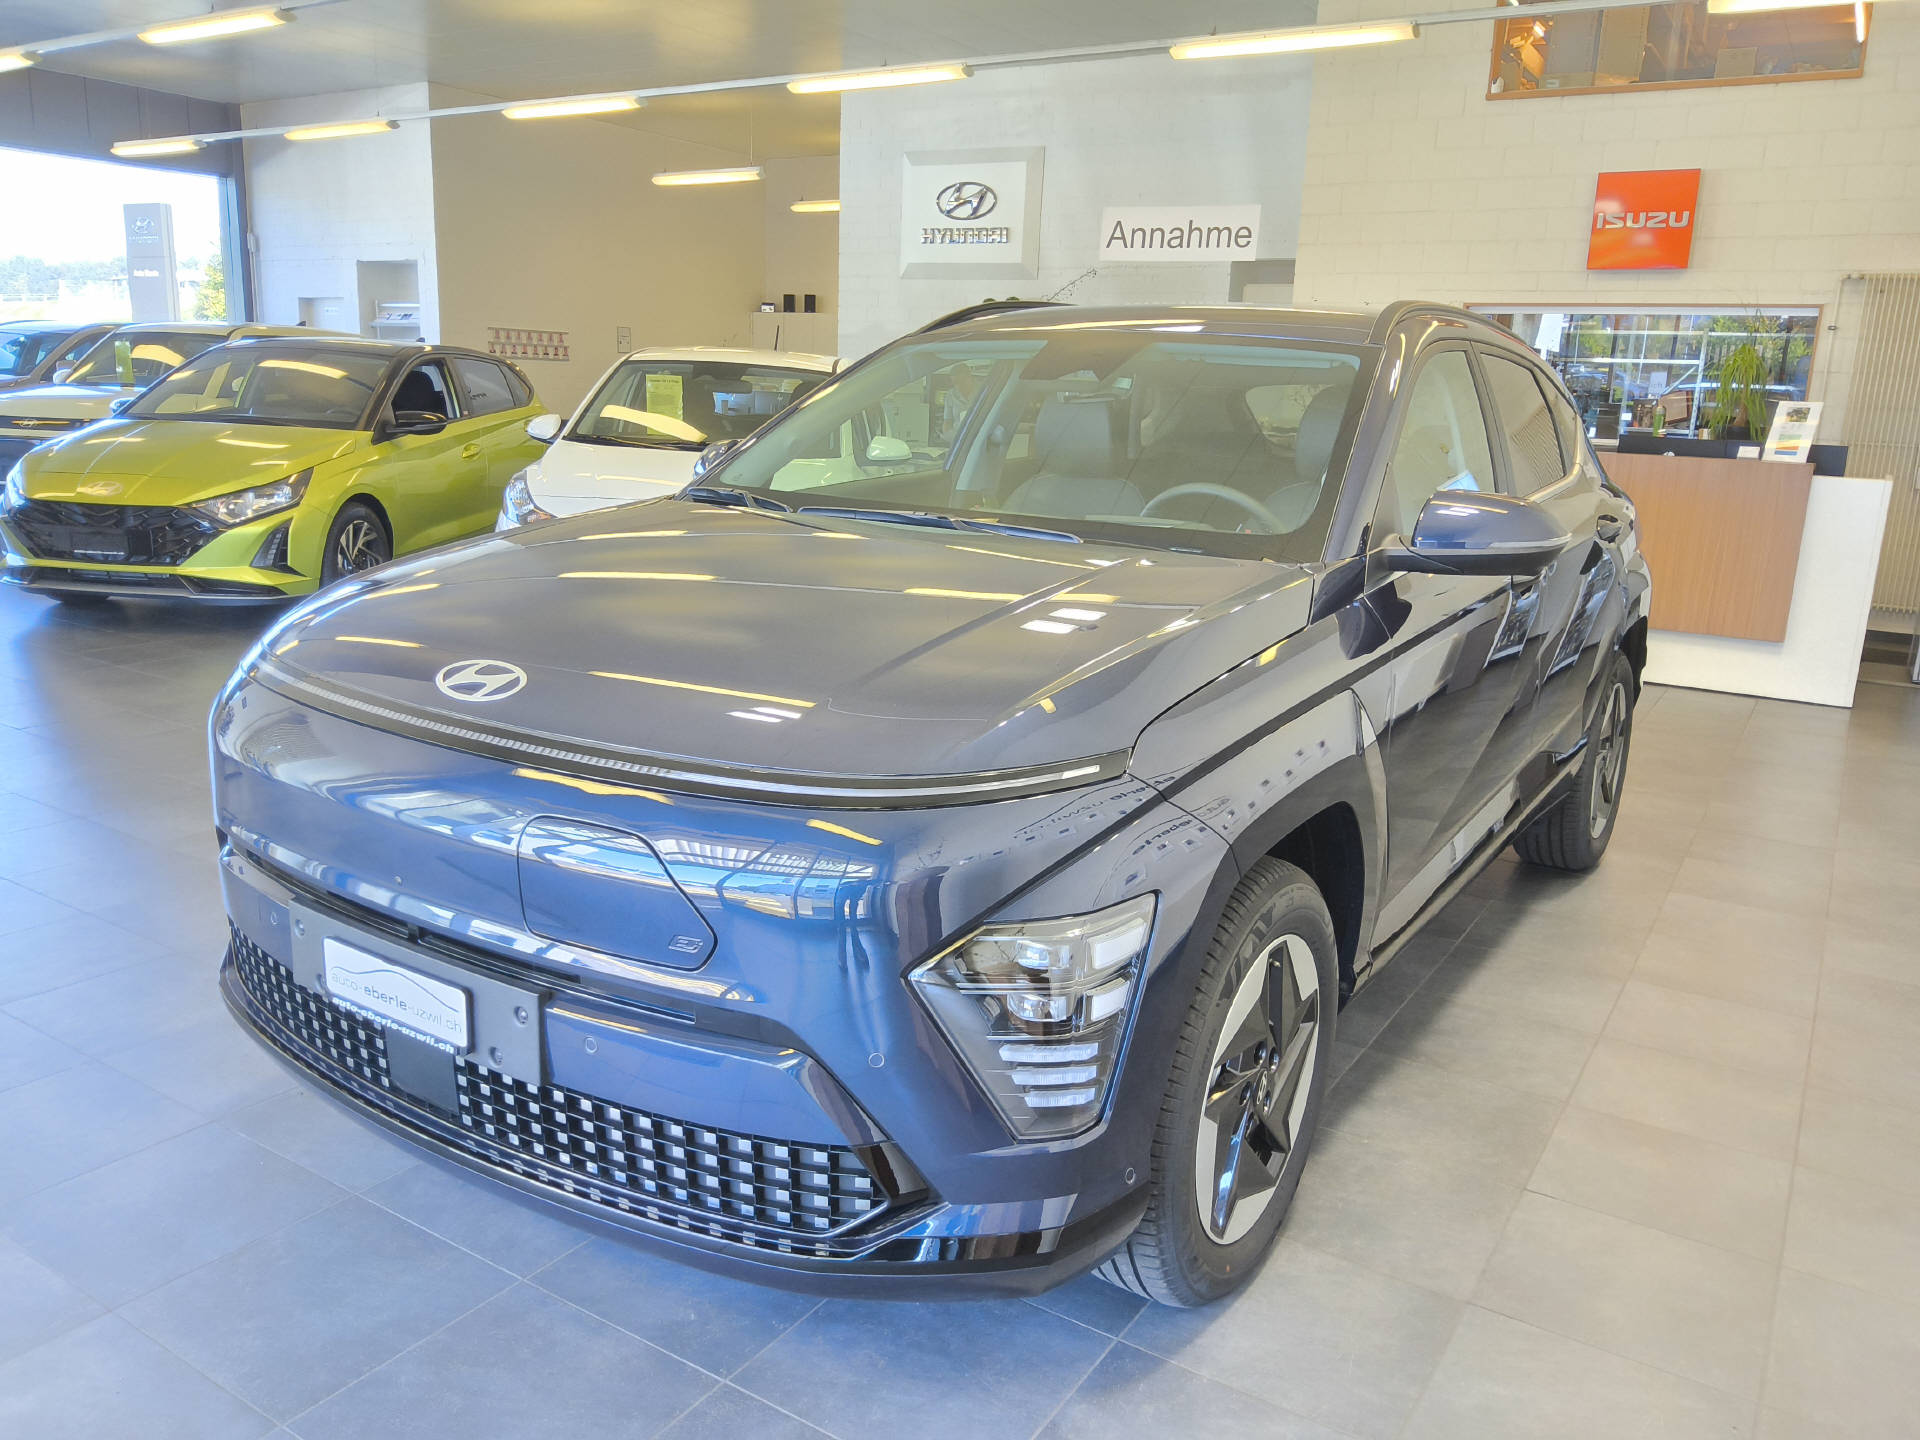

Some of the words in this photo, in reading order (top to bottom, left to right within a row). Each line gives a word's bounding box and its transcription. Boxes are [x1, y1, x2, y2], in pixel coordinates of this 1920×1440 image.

[1596, 211, 1690, 229] ISUZU
[920, 227, 1010, 244] HYUNDAI
[1105, 219, 1253, 249] Annahme
